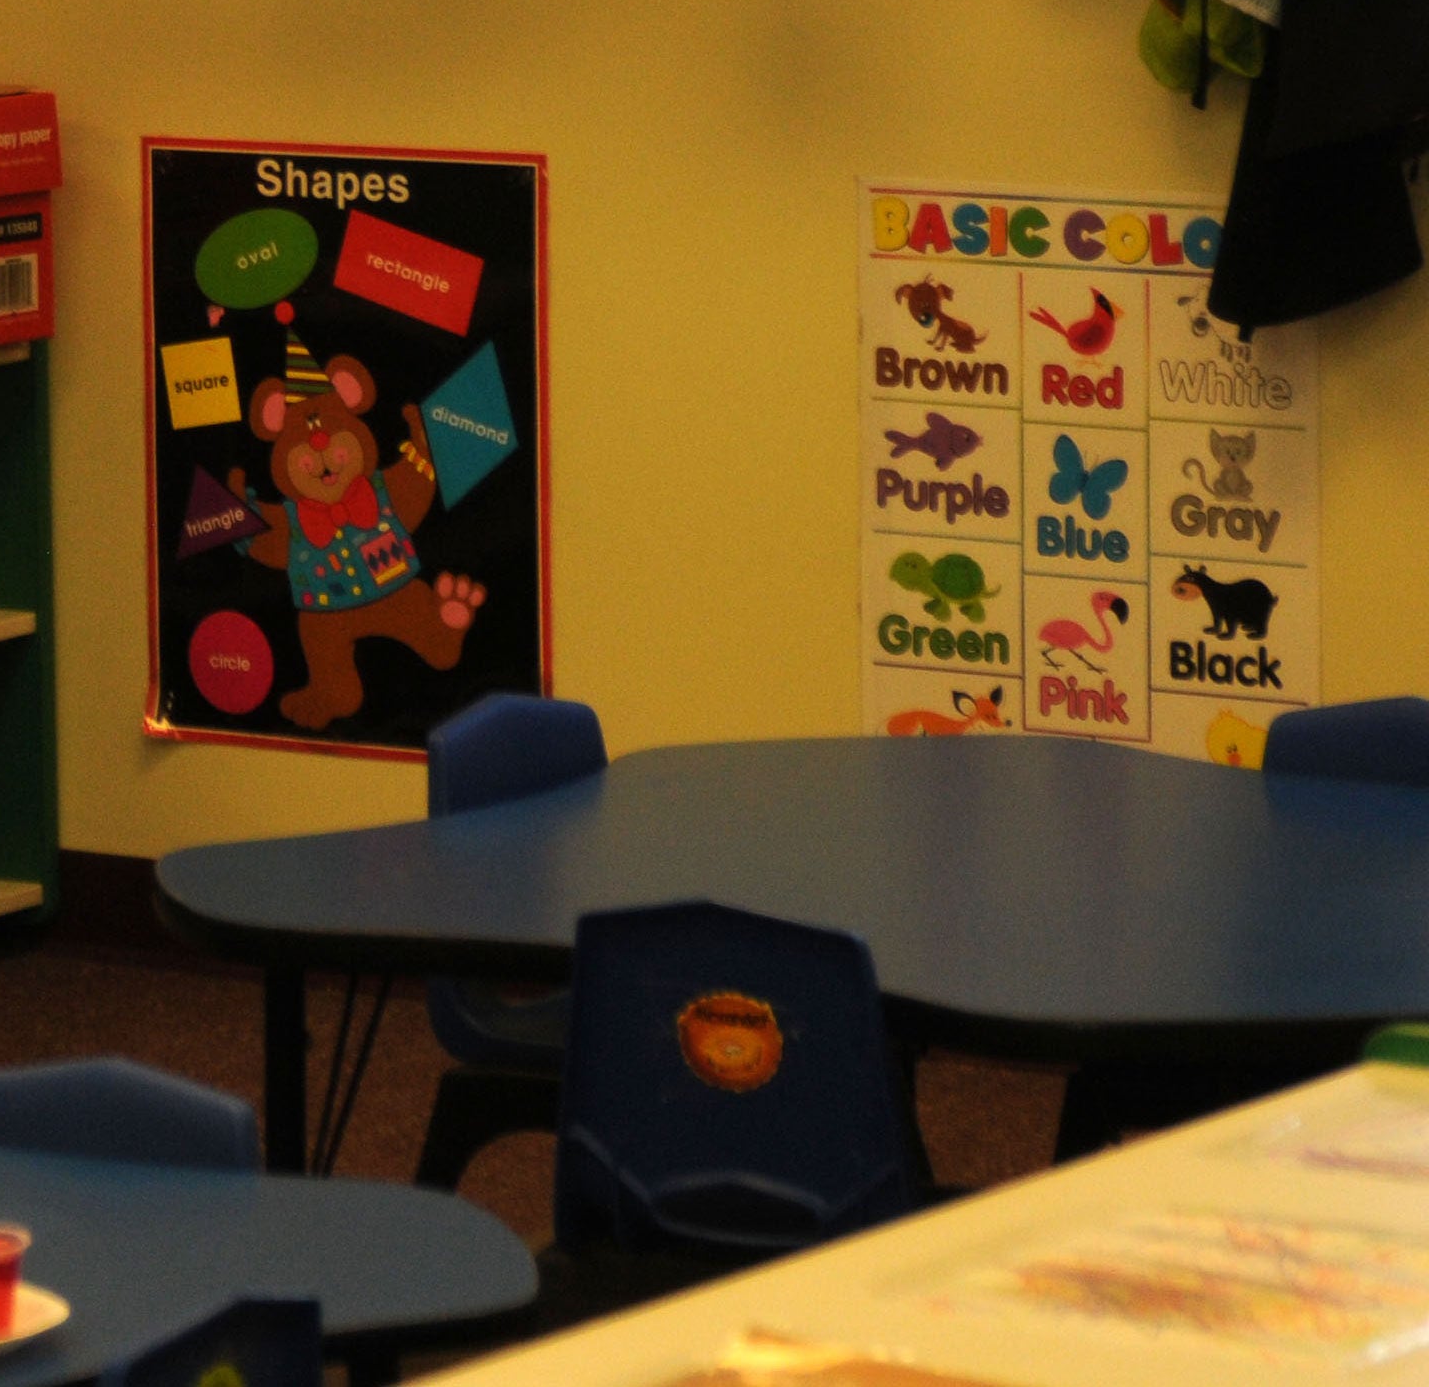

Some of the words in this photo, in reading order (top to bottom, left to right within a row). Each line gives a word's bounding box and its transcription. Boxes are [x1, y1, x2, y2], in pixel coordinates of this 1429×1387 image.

[20, 127, 52, 147] paper
[256, 157, 411, 210] Shapes
[236, 241, 280, 271] oval
[873, 195, 1050, 258] BASIC
[1063, 209, 1223, 269] COLO
[366, 251, 451, 294] rectangle
[174, 373, 230, 395] square
[875, 346, 1009, 396] Brown
[1041, 364, 1124, 409] Red
[1159, 358, 1293, 410] White
[430, 405, 510, 446] diamond
[876, 467, 1011, 525] Purple
[184, 505, 246, 540] triangle
[1037, 514, 1130, 562] Blue
[1171, 493, 1281, 553] Gray
[208, 652, 251, 672] circle
[878, 613, 1010, 666] Green
[1170, 640, 1284, 691] Black
[1040, 675, 1130, 725] Pink
